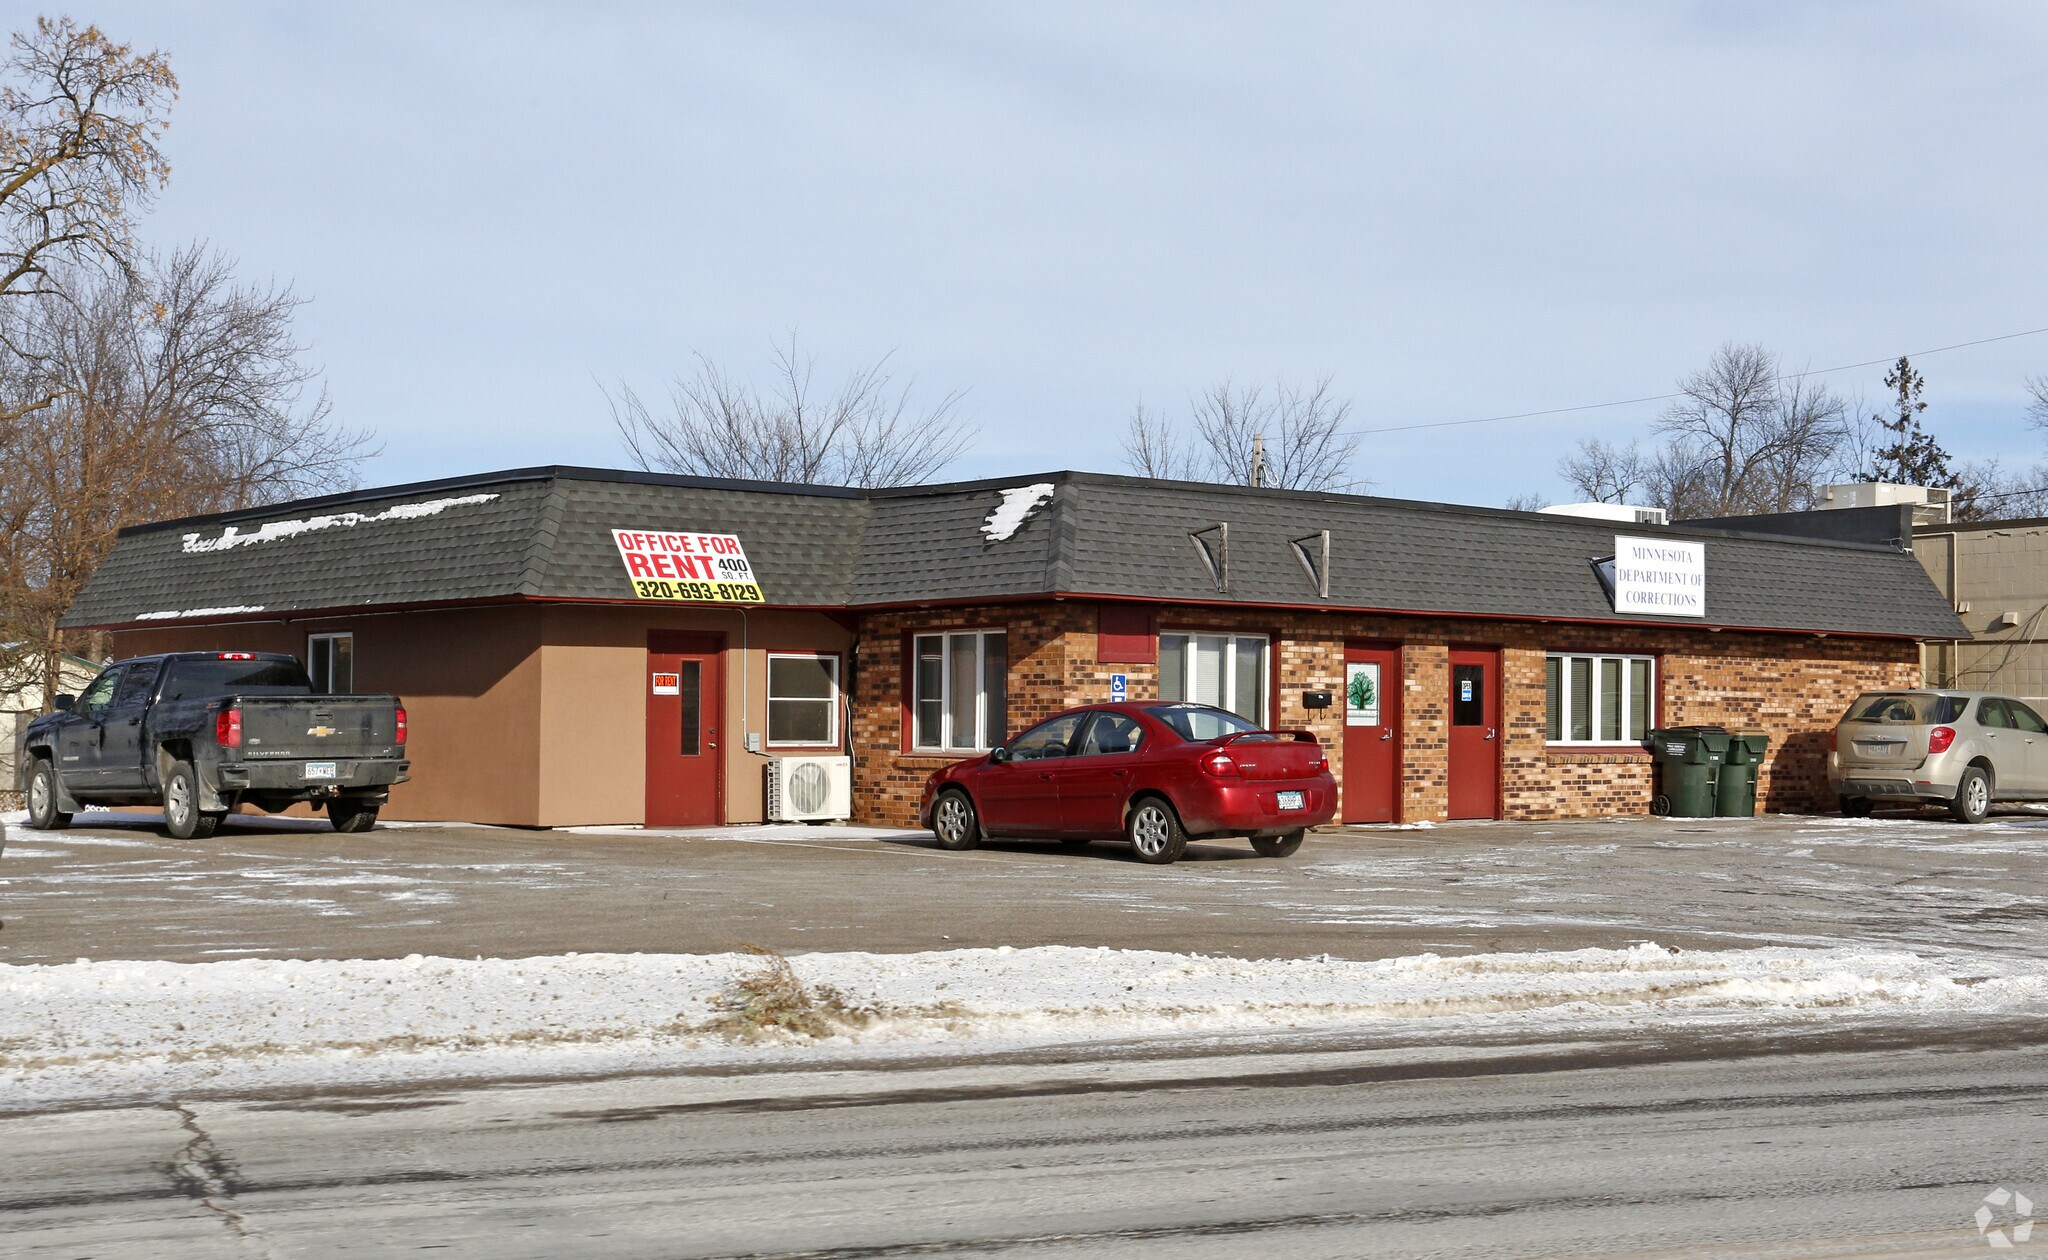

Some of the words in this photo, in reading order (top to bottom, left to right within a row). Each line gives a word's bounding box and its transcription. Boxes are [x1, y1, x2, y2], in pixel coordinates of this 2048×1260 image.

[618, 532, 694, 553] OFFICE
[697, 536, 741, 555] FOR
[1632, 546, 1693, 563] MINNESOTA
[625, 553, 716, 580] RENT
[718, 558, 748, 572] 400
[722, 571, 737, 580] SQ.
[739, 572, 752, 580] FT.
[1619, 568, 1689, 586] DEPARTMENT
[1690, 573, 1702, 586] OF
[636, 581, 760, 601] 320-693-8129
[1626, 590, 1697, 607] CORRECTIONS
[656, 675, 665, 686] FOR
[665, 675, 676, 686] RENT
